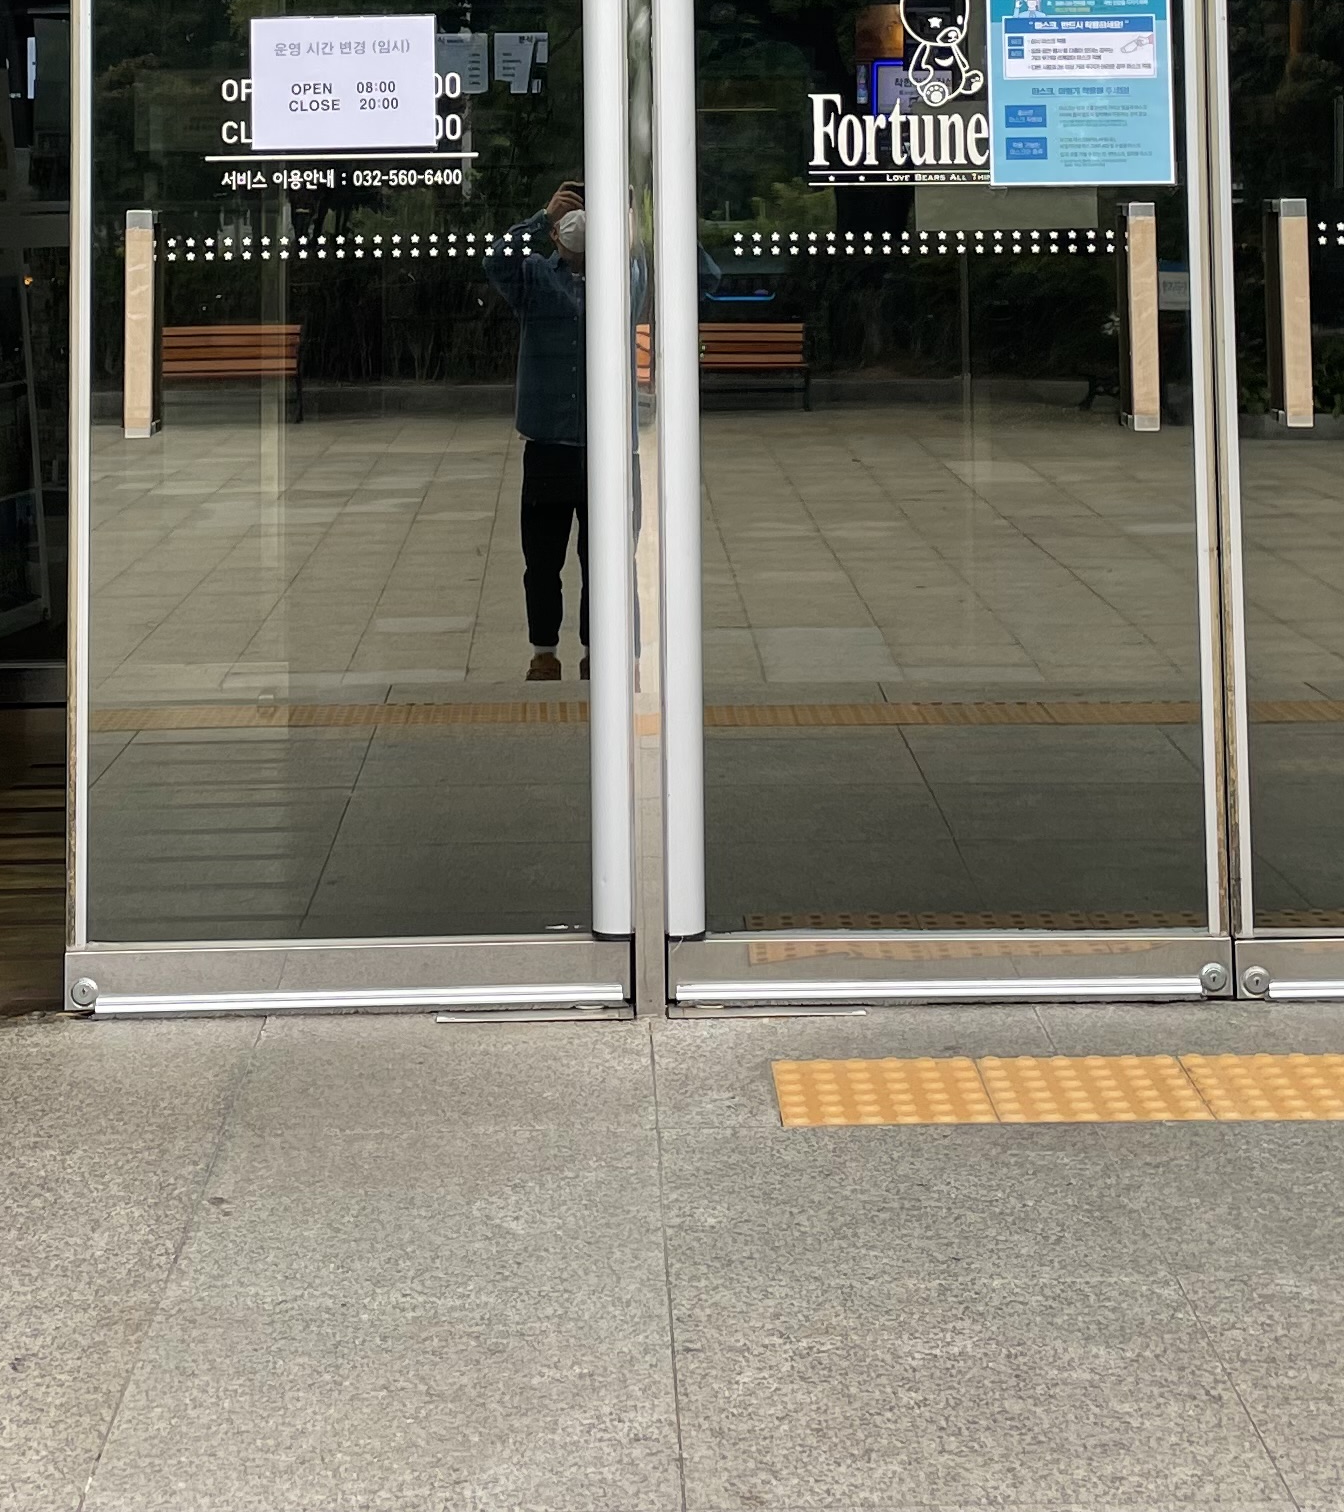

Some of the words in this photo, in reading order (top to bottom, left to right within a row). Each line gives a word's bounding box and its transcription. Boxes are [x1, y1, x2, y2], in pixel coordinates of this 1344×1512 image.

[273, 42, 301, 57] 운영
[306, 41, 335, 56] 시간
[339, 40, 366, 55] 변경
[371, 39, 411, 55] (임시)
[291, 82, 333, 96] OPEN
[356, 80, 396, 94] 08:00
[288, 99, 341, 113] CLOSE
[359, 97, 399, 111] 20:00
[807, 93, 990, 167] Fortune
[221, 170, 267, 190] 서비스
[272, 169, 335, 189] 이용안내
[353, 169, 462, 187] 032-560-6400
